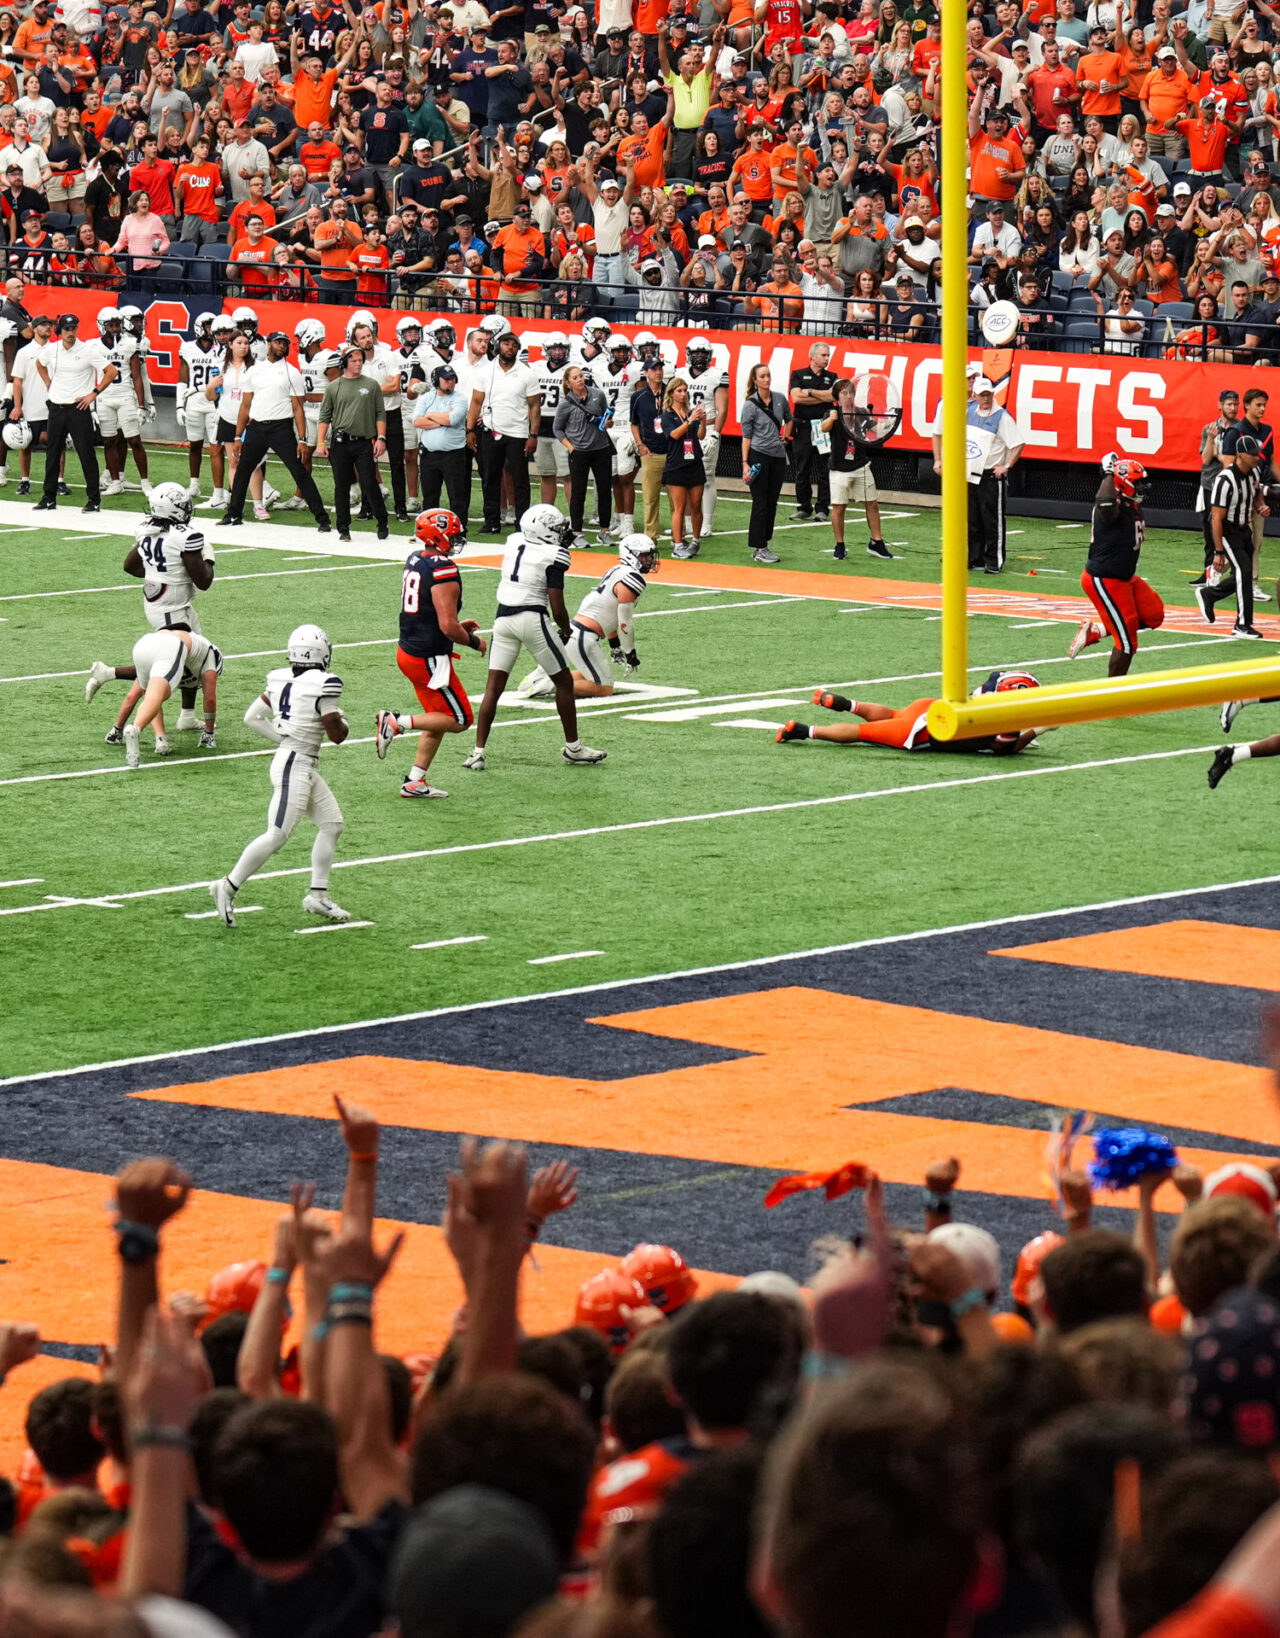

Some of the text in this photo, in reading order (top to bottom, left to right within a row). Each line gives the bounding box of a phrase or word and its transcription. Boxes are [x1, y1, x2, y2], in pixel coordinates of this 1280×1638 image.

[777, 10, 792, 24] 15
[309, 30, 333, 52] 44
[374, 112, 387, 127] S
[189, 174, 211, 188] Cuse
[551, 176, 563, 192] S
[144, 300, 190, 387] S
[538, 378, 562, 386] WILDCATS
[608, 388, 619, 407] 7
[1117, 463, 1130, 477] S
[435, 514, 448, 530] S
[141, 536, 168, 573] 94
[510, 545, 526, 583] 1
[279, 682, 293, 720] 4
